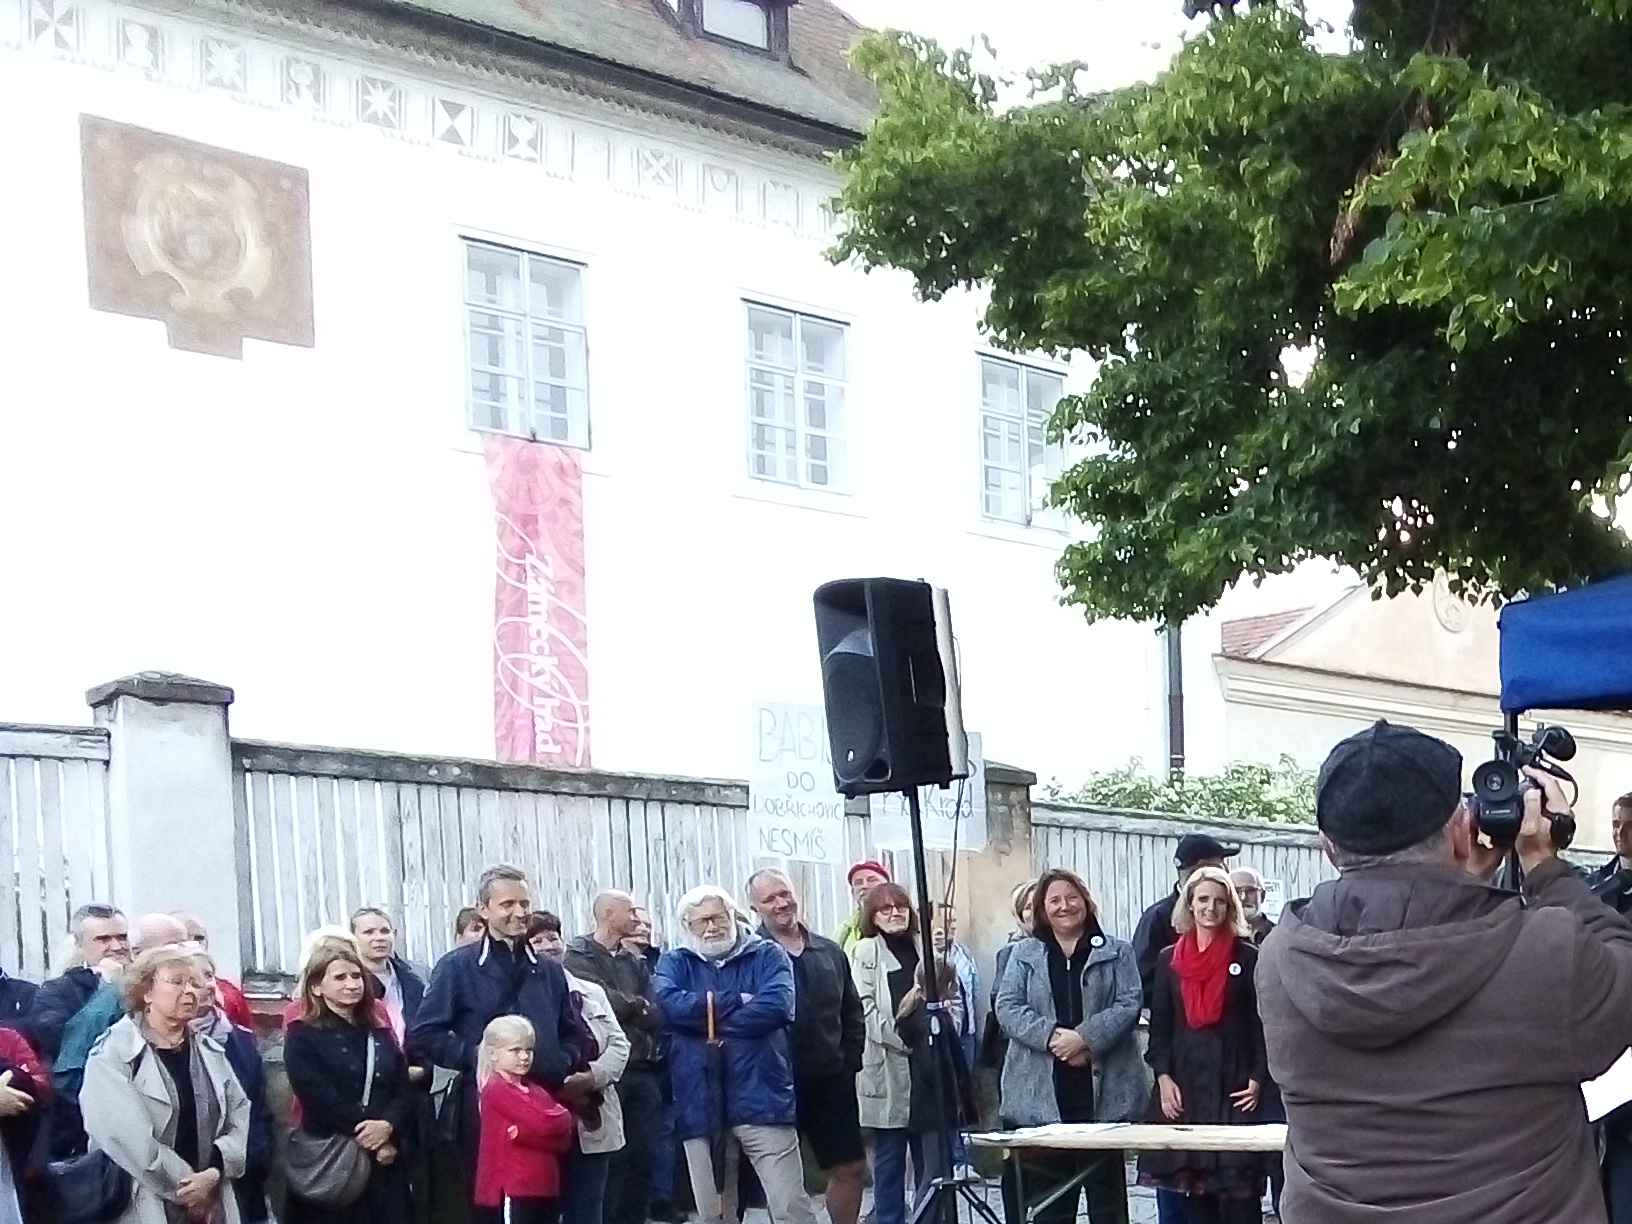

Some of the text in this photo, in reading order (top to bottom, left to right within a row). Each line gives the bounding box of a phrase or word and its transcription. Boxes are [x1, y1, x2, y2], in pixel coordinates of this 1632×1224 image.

[523, 553, 561, 691] Zámecký
[758, 707, 834, 767] BABI
[786, 771, 816, 792] DO
[758, 827, 827, 860] NESMÍŠ
